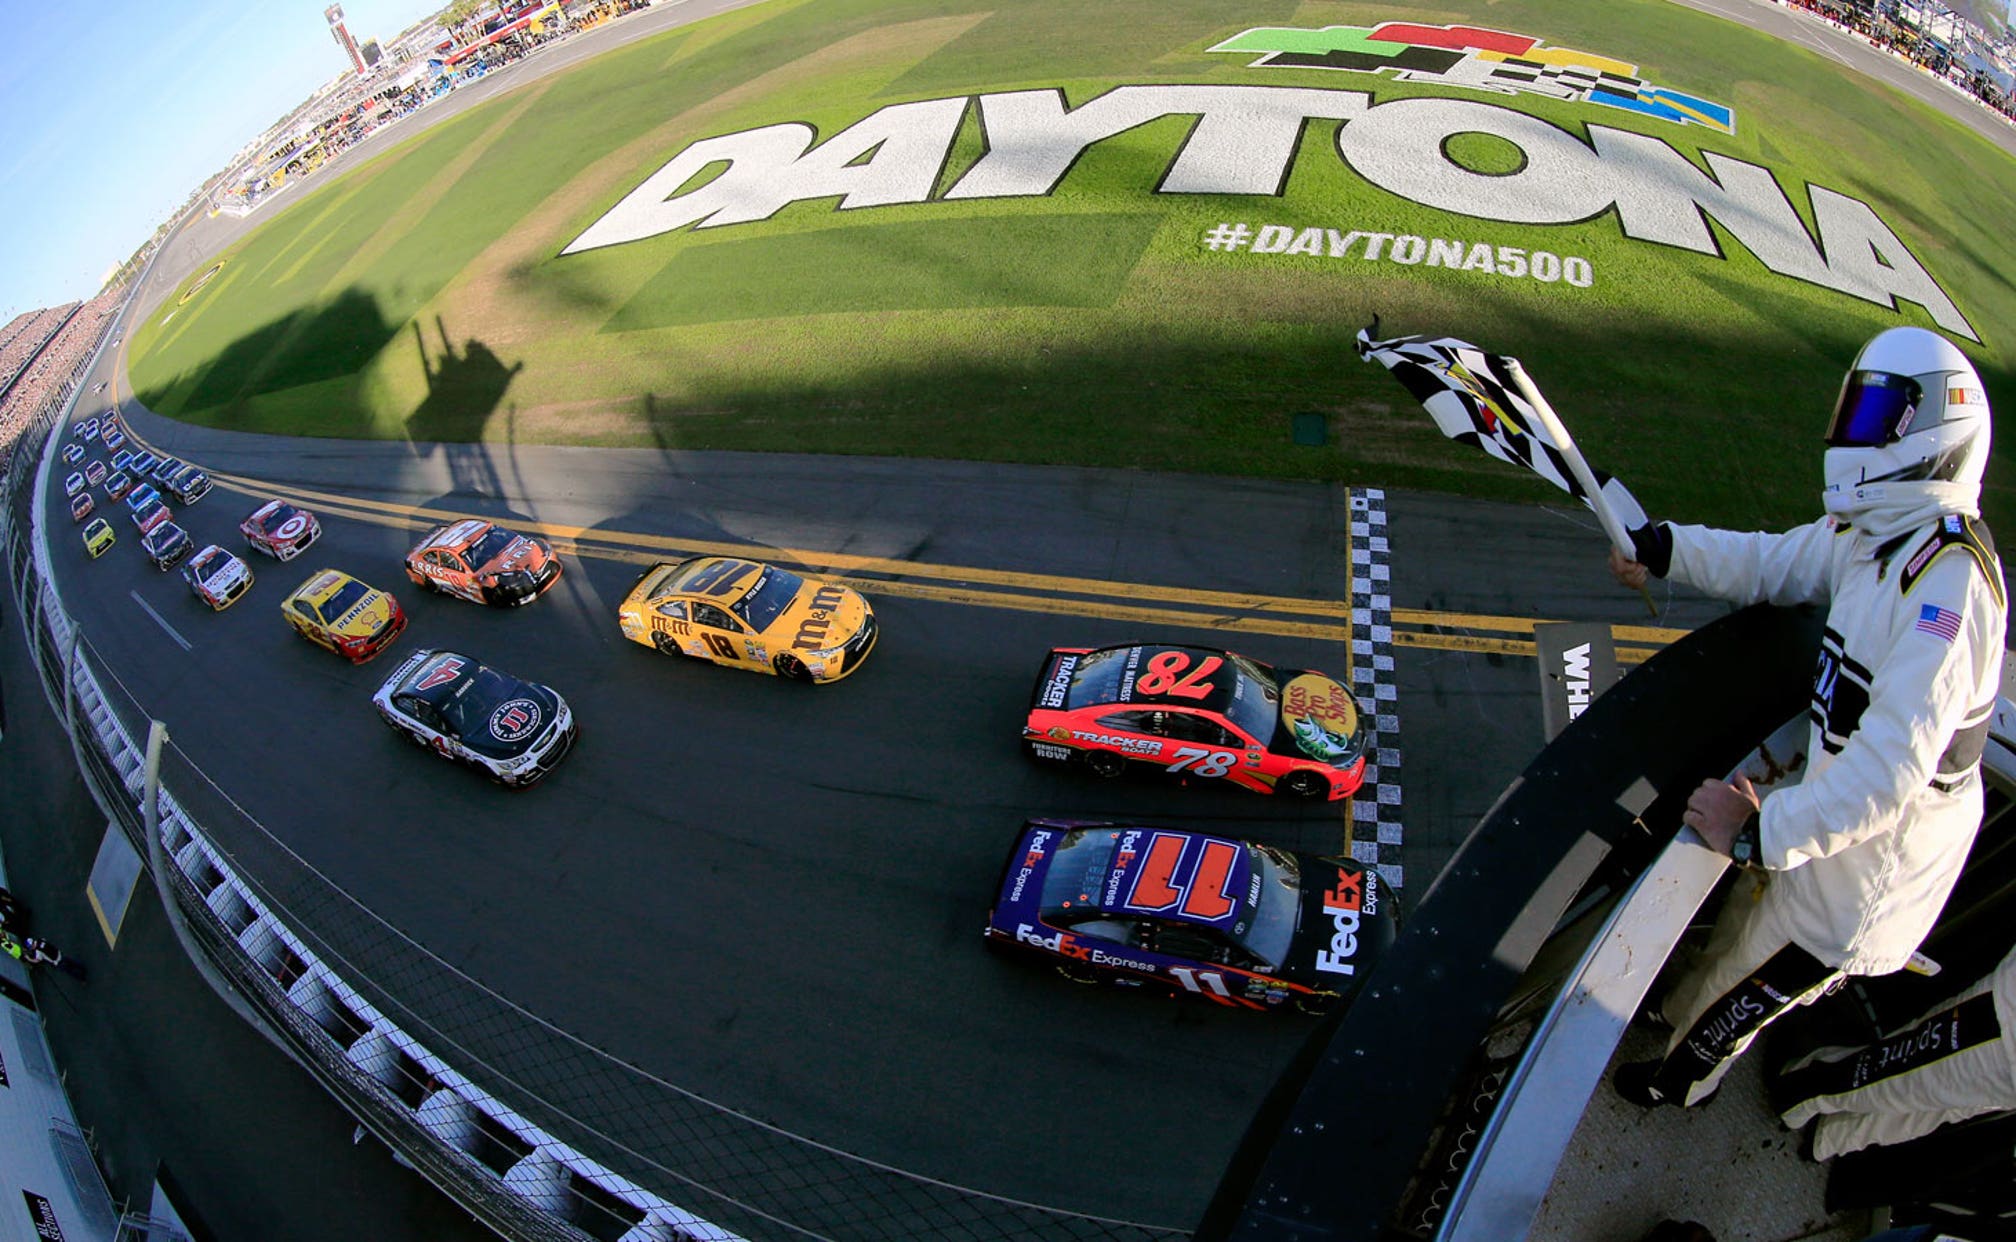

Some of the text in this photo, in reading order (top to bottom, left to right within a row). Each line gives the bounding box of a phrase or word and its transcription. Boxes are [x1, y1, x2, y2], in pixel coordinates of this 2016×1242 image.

[556, 84, 1985, 344] DAYTONA
[1203, 222, 1594, 288] #DAYTONA500
[337, 593, 379, 630] PENNZOIL
[701, 632, 740, 660] 18
[416, 657, 465, 691] 4
[1047, 656, 1077, 708] TRACKER
[1136, 651, 1224, 700] 78
[1284, 685, 1307, 718] Bass
[1306, 694, 1327, 721] Pro
[1325, 684, 1346, 724] Shops
[1036, 749, 1067, 761] ROW
[1071, 730, 1163, 752] TRACKER
[1165, 747, 1237, 778] 78
[1010, 830, 1052, 903] FedEx Express
[1104, 830, 1142, 906] FedEx Express
[1124, 832, 1240, 921] 11
[1362, 871, 1377, 916] Express
[1316, 867, 1363, 976] FedEx
[1016, 924, 1155, 973] FedEx Express
[1169, 966, 1231, 997] 11
[1703, 995, 1765, 1045] Sprint
[1879, 1022, 1943, 1069] Sprint
